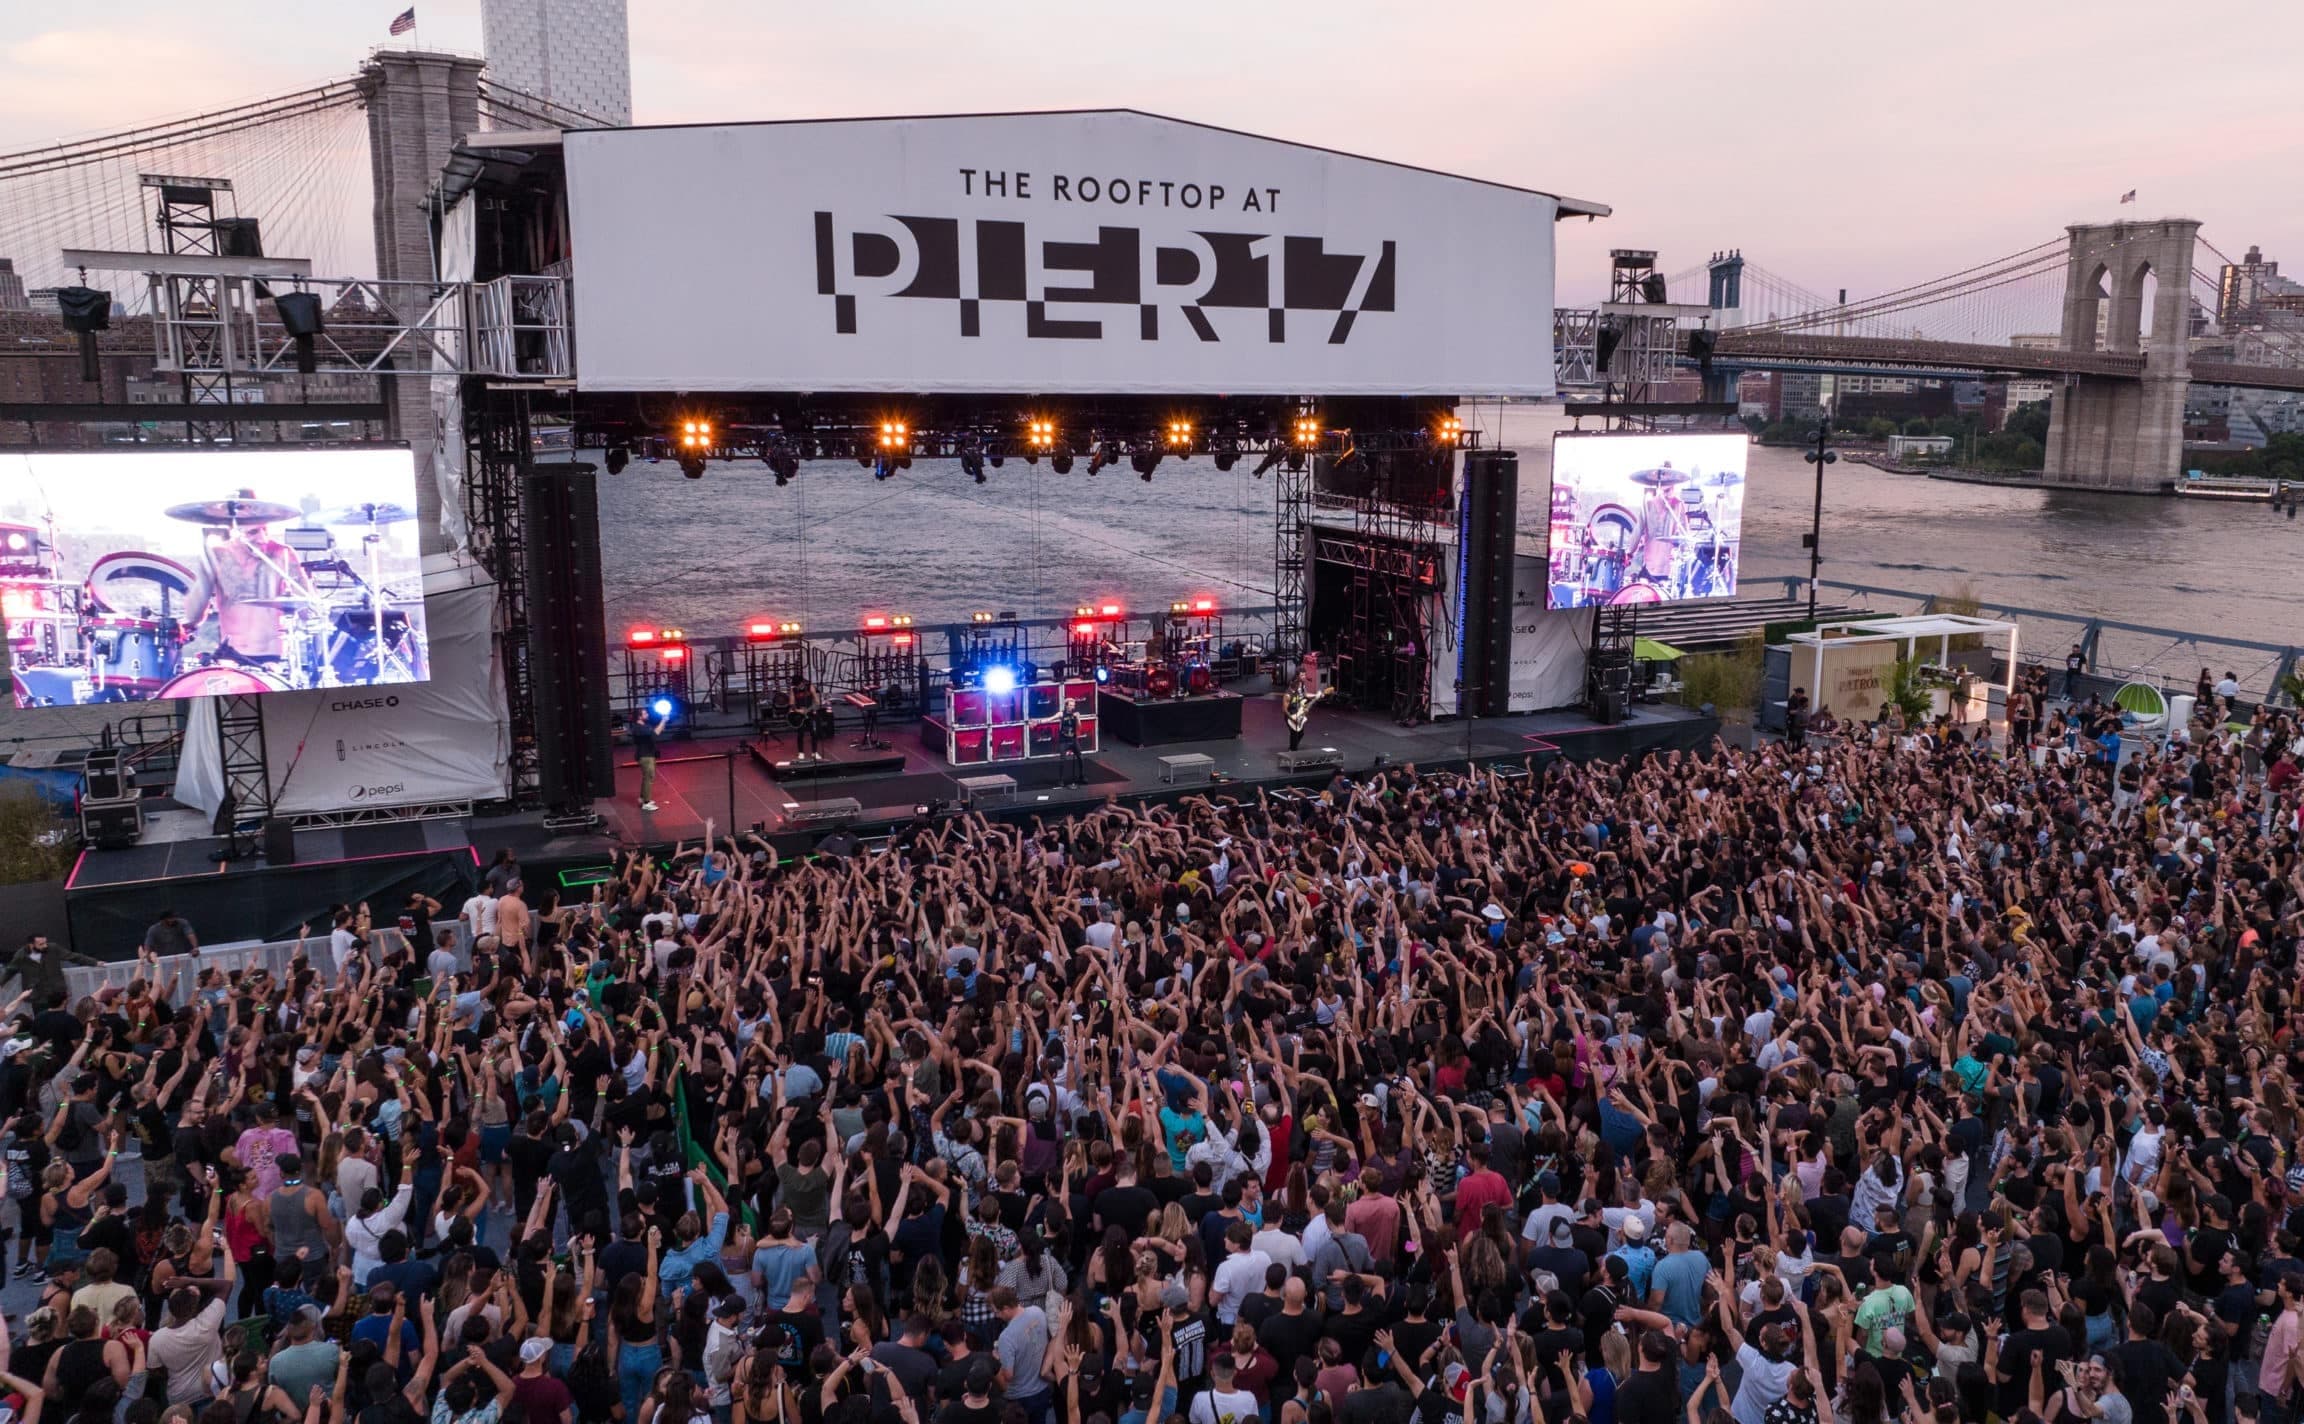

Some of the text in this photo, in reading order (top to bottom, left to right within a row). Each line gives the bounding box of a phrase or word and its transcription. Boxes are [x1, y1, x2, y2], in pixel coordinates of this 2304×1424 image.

[959, 169, 1281, 213] THE ROOFTOP AT
[332, 698, 384, 711] CHASE
[369, 783, 404, 796] pepsi
